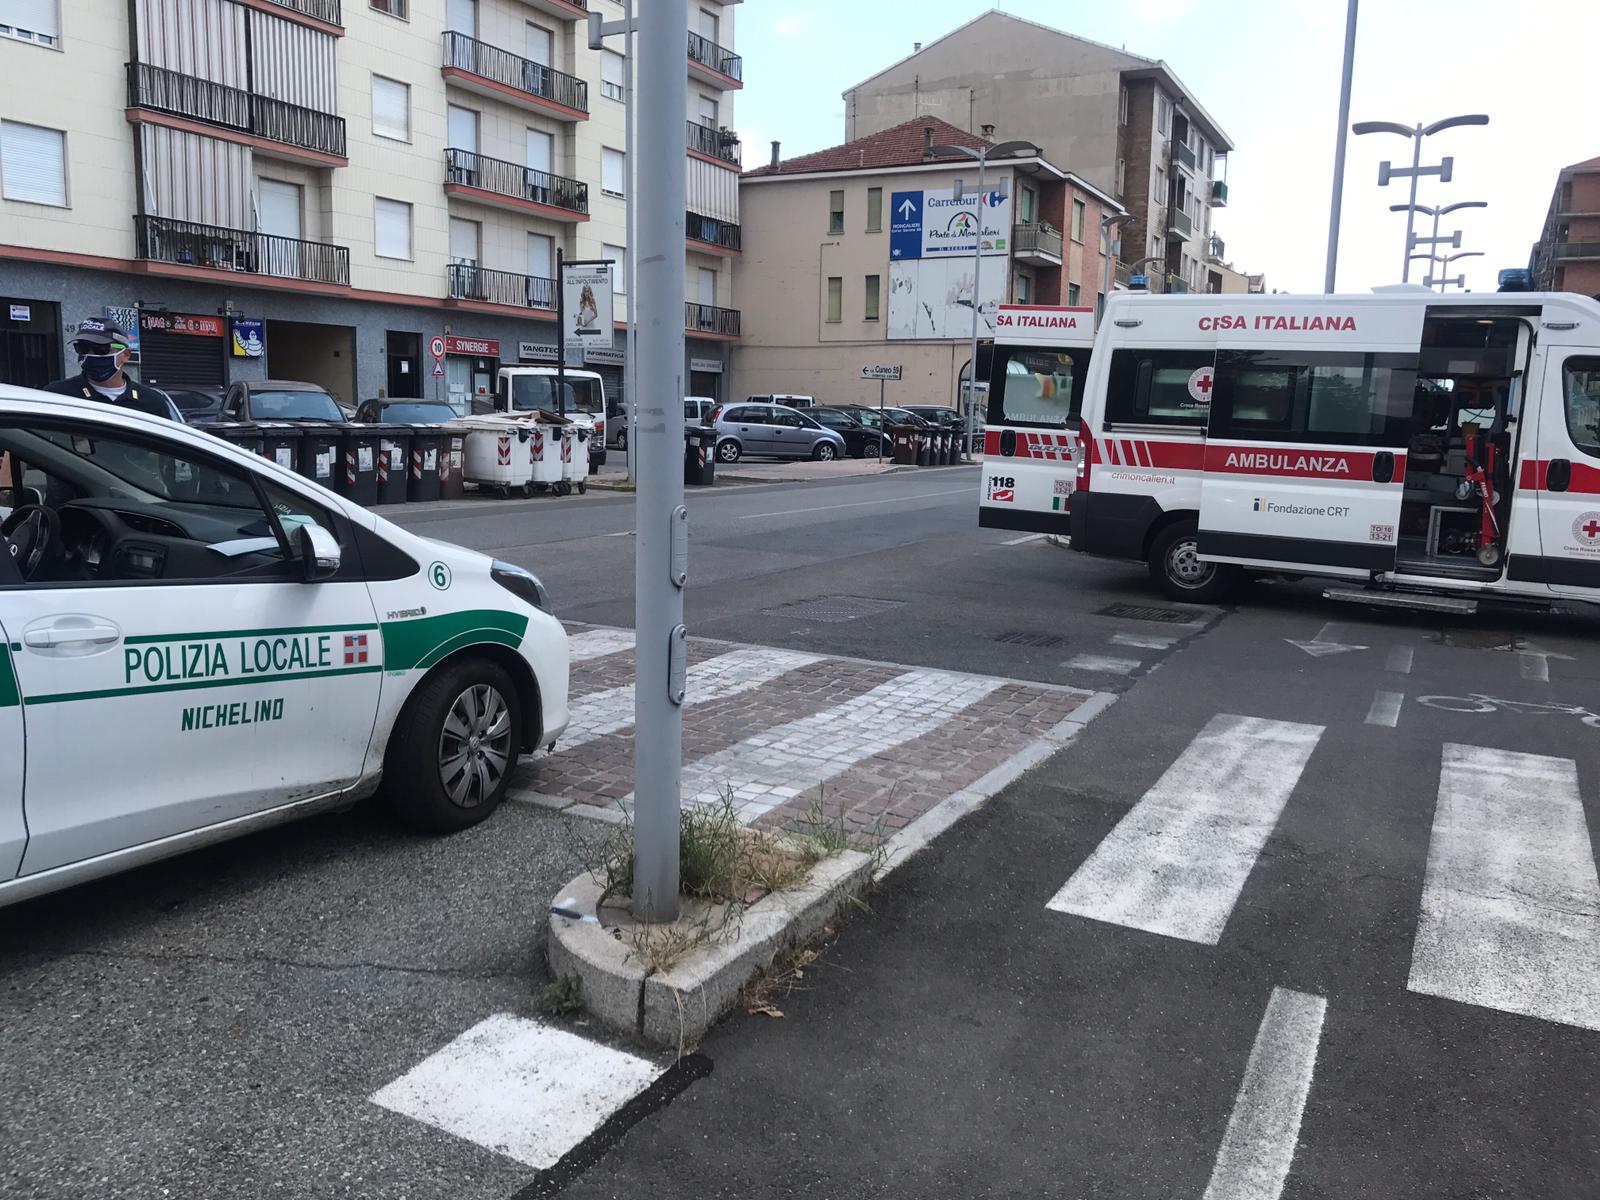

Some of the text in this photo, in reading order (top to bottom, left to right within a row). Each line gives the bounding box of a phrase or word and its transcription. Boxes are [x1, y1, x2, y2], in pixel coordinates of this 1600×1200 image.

[957, 226, 1000, 238] Monalieri
[1017, 316, 1077, 328] ITALIANA
[1254, 315, 1357, 331] ITALIANA
[434, 342, 442, 352] 10
[456, 340, 489, 353] SYNERGIE
[522, 344, 561, 354] YANGTEC
[875, 365, 892, 374] Cuneo
[1003, 412, 1067, 424] AMBULANZA
[1225, 452, 1349, 473] AMBULANZA
[992, 476, 1015, 488] 118
[1111, 471, 1175, 485] crimoncalieri.it
[1267, 502, 1350, 517] Fondazione CRT
[433, 564, 446, 587] 6
[125, 636, 331, 683] POLIZIA LOCALE
[181, 698, 284, 731] NICHELINO
